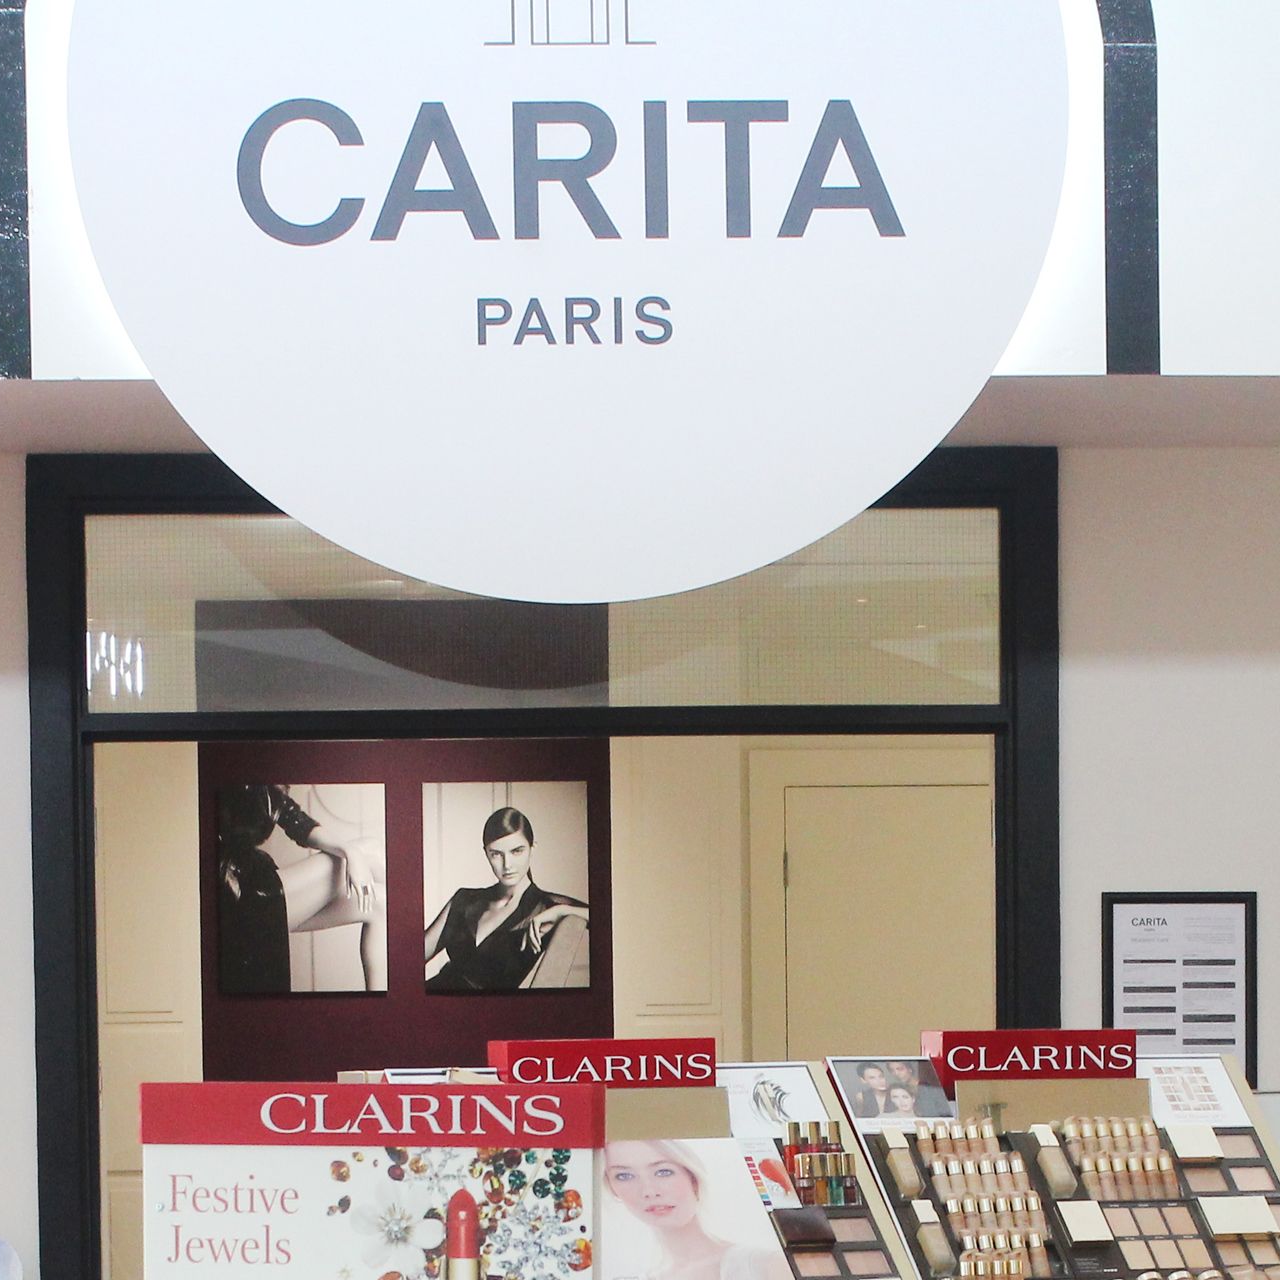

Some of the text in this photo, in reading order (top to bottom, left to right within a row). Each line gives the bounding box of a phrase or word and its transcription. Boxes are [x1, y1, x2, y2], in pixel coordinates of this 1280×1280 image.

[236, 97, 906, 247] CARITA
[476, 295, 673, 346] PARIS
[1131, 917, 1168, 927] CARITA
[511, 1052, 713, 1085] CLARINS
[946, 1042, 1134, 1074] CLARINS
[259, 1092, 566, 1136] CLARINS
[167, 1172, 300, 1216] Festive
[166, 1224, 292, 1266] Jewels
